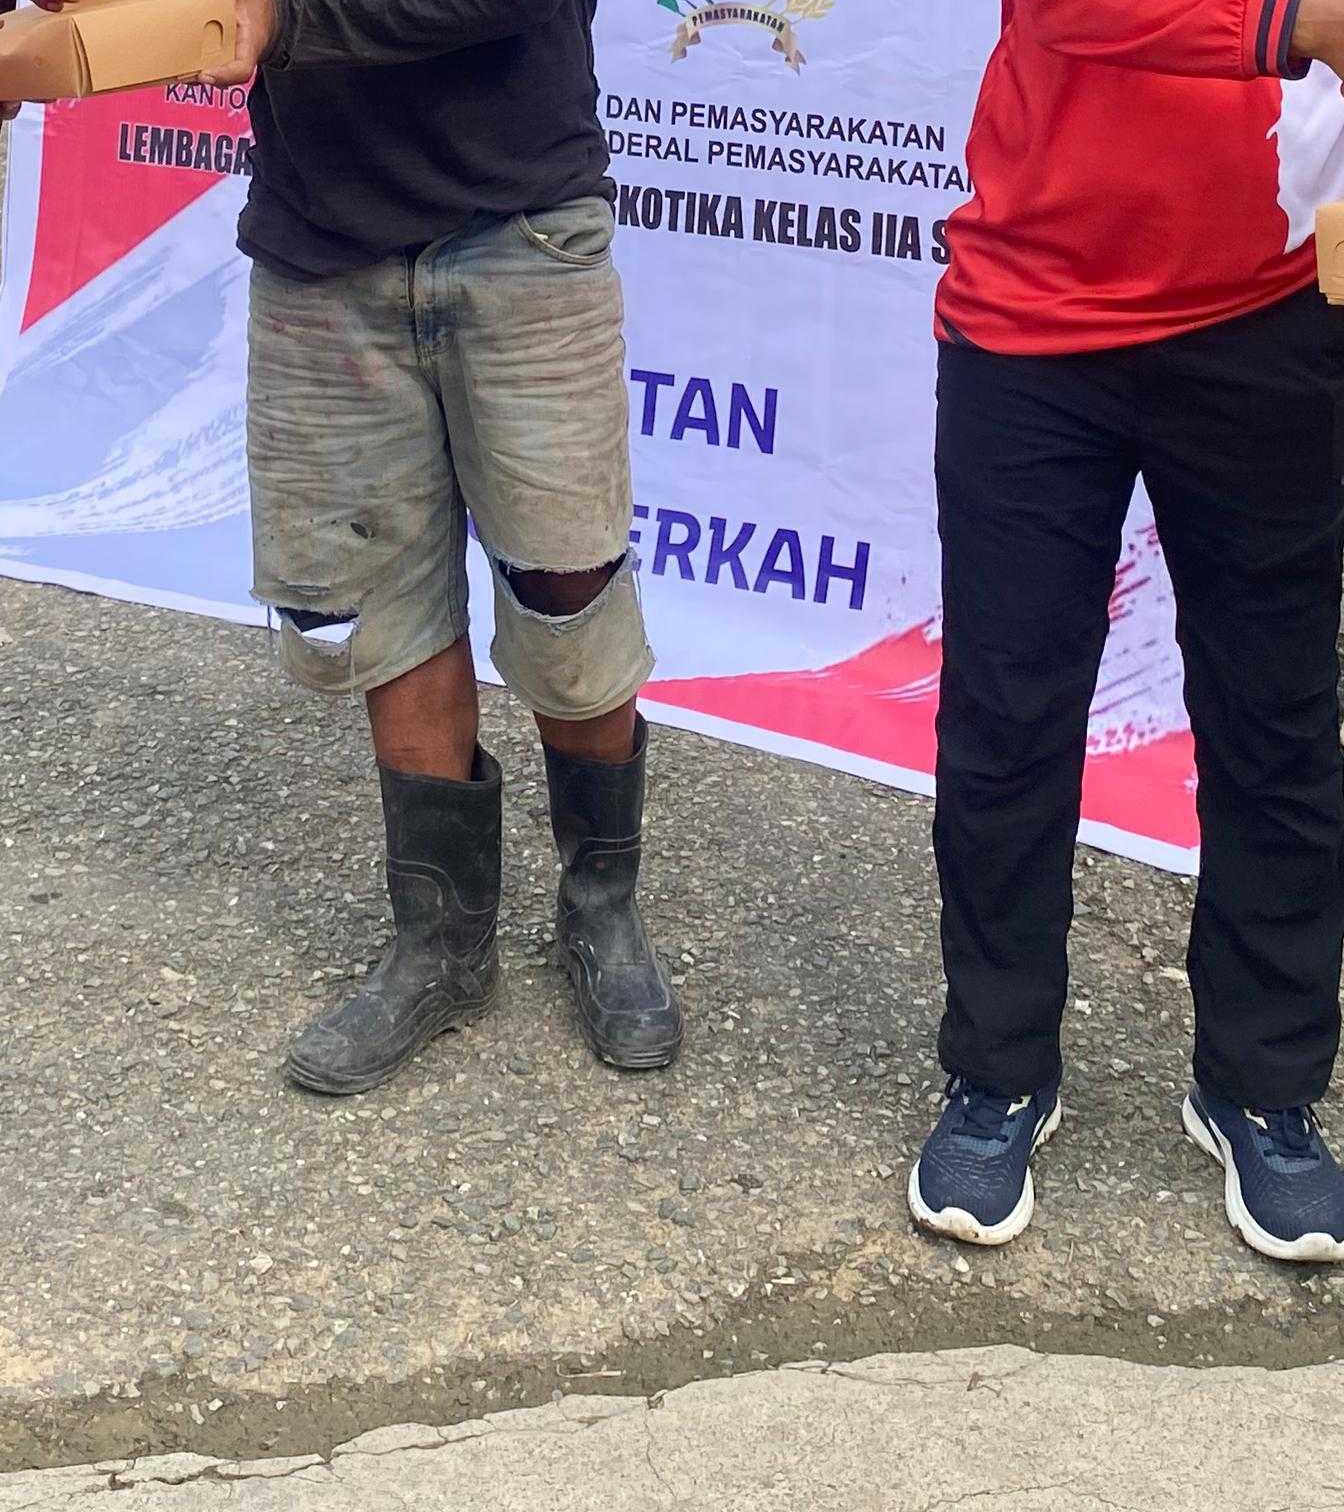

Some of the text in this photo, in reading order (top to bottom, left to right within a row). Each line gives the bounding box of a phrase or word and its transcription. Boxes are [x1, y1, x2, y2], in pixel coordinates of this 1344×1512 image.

[166, 82, 247, 110] KANTO
[606, 94, 945, 152] DAN PEMASYARAKATAN
[118, 122, 254, 176] LEMBAGA
[614, 184, 744, 240] KOTIKA
[753, 199, 861, 252] KELAS
[871, 213, 922, 261] IIA
[630, 368, 778, 455] TAN
